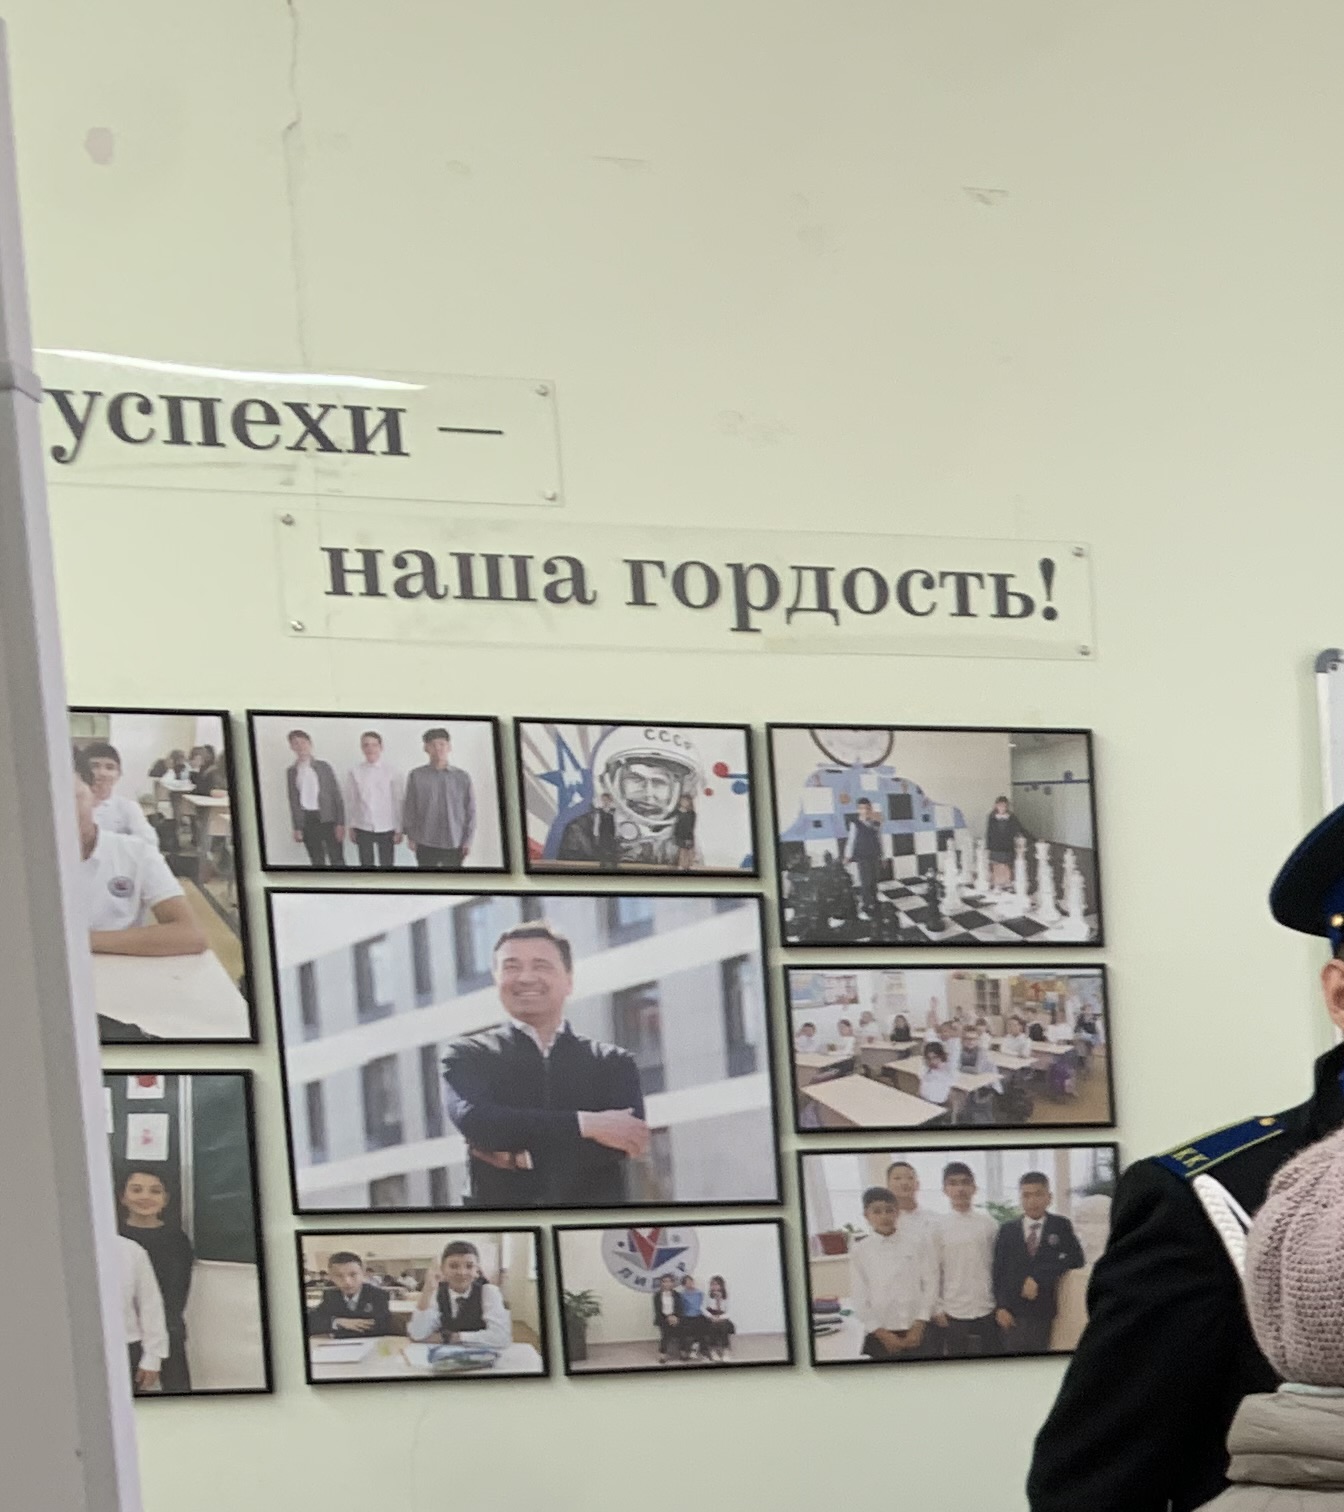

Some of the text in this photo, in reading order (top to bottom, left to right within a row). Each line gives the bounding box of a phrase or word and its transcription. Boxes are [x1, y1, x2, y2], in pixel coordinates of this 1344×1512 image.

[43, 386, 411, 465] успехи
[322, 543, 1061, 633] наша гордость!
